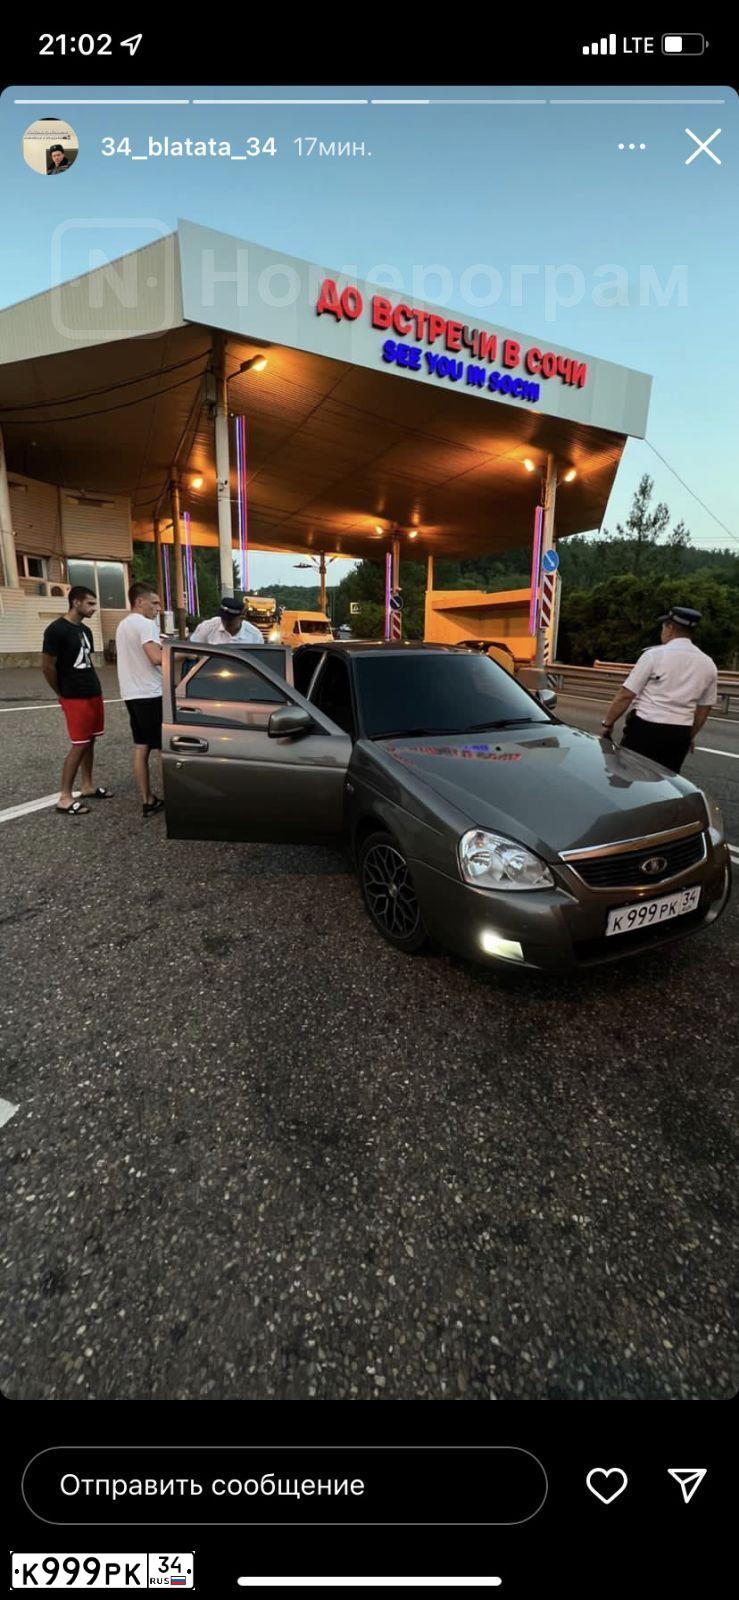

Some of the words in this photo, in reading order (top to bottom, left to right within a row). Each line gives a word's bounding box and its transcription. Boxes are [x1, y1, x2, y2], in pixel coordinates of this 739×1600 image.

[316, 278, 363, 321] ДО
[371, 295, 497, 363] ВСТРЕЧИ
[503, 338, 520, 369] В
[525, 347, 587, 388] СОЧИ
[382, 339, 422, 371] SEE
[424, 351, 463, 382] YOU
[466, 364, 486, 388] IN
[487, 370, 540, 403] SOCHI
[682, 890, 696, 906] 34
